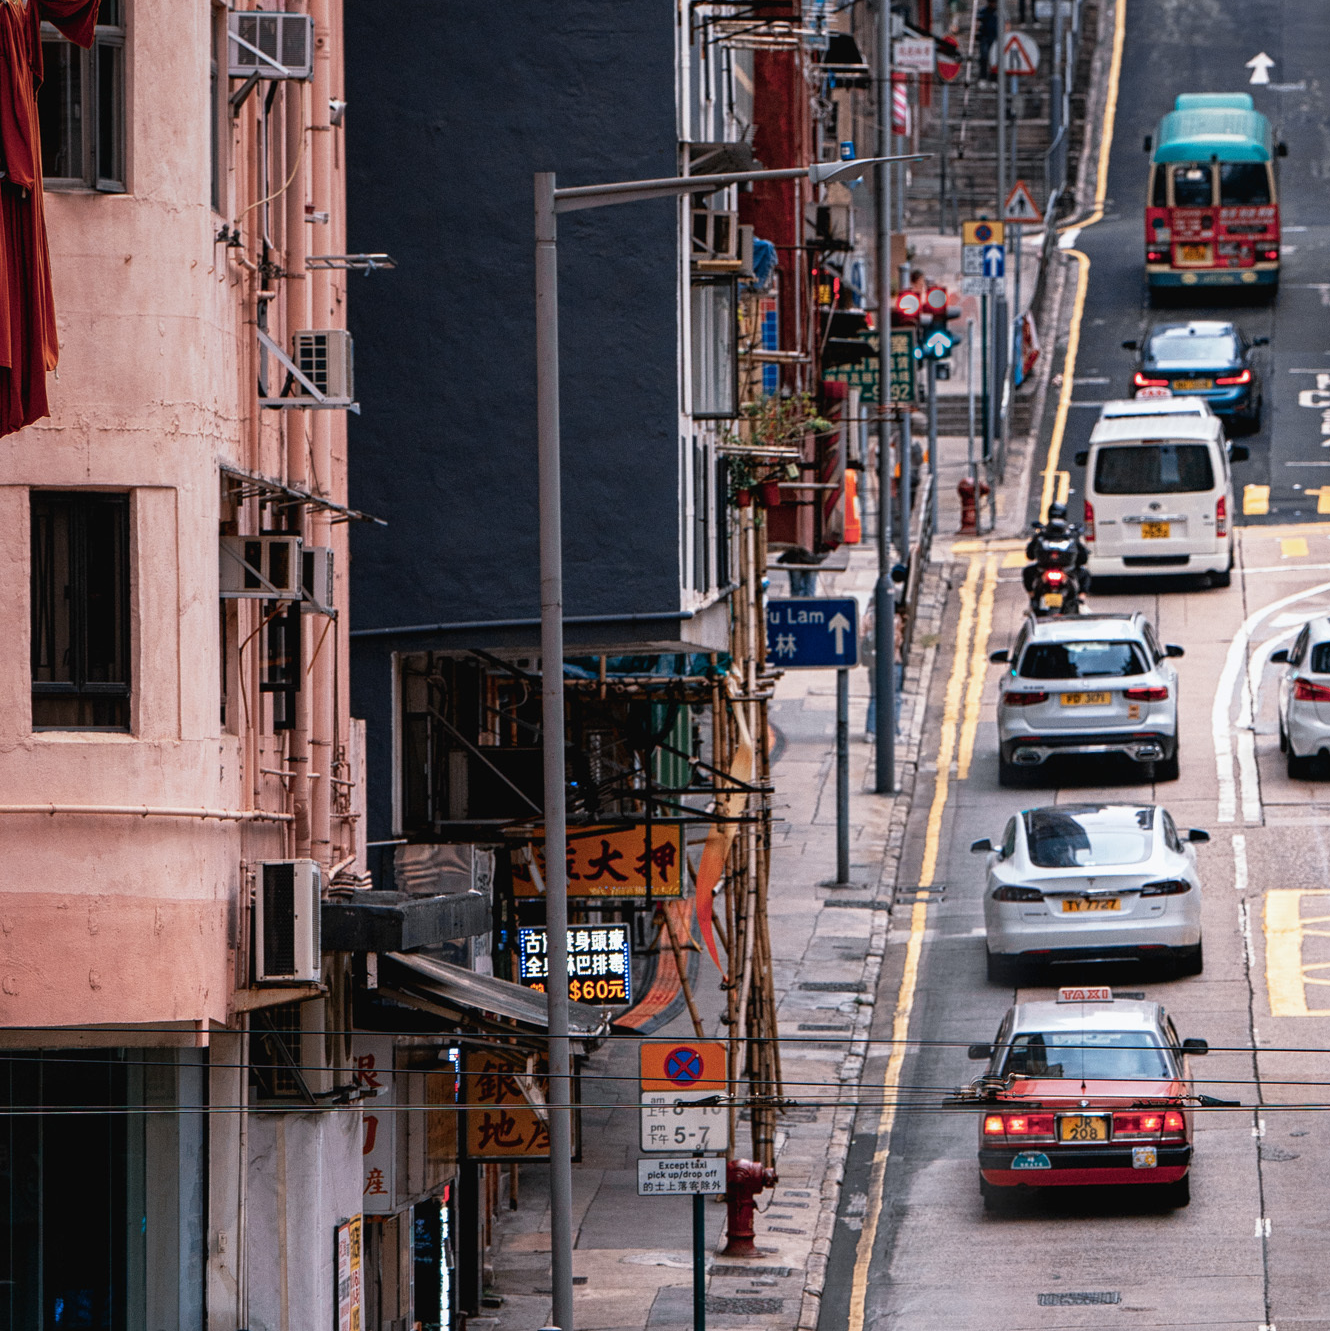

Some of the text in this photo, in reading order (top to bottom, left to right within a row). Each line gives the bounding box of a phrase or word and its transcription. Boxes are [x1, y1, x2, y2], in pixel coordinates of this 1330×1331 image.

[787, 607, 825, 624] Lam
[525, 928, 625, 953] 古身頭療
[525, 953, 625, 978] 全巴排毒
[569, 979, 625, 1001] $60元
[1062, 989, 1108, 1000] TAXI
[650, 1097, 665, 1105] am
[1074, 1116, 1092, 1128] JR
[647, 1134, 669, 1145] 下午
[650, 1124, 710, 1144] pm 5-7
[1070, 1128, 1098, 1140] 208
[659, 1160, 707, 1171] Except taxi
[647, 1169, 717, 1180] pick up/drop off
[643, 1180, 721, 1193] 的士上落客除外
